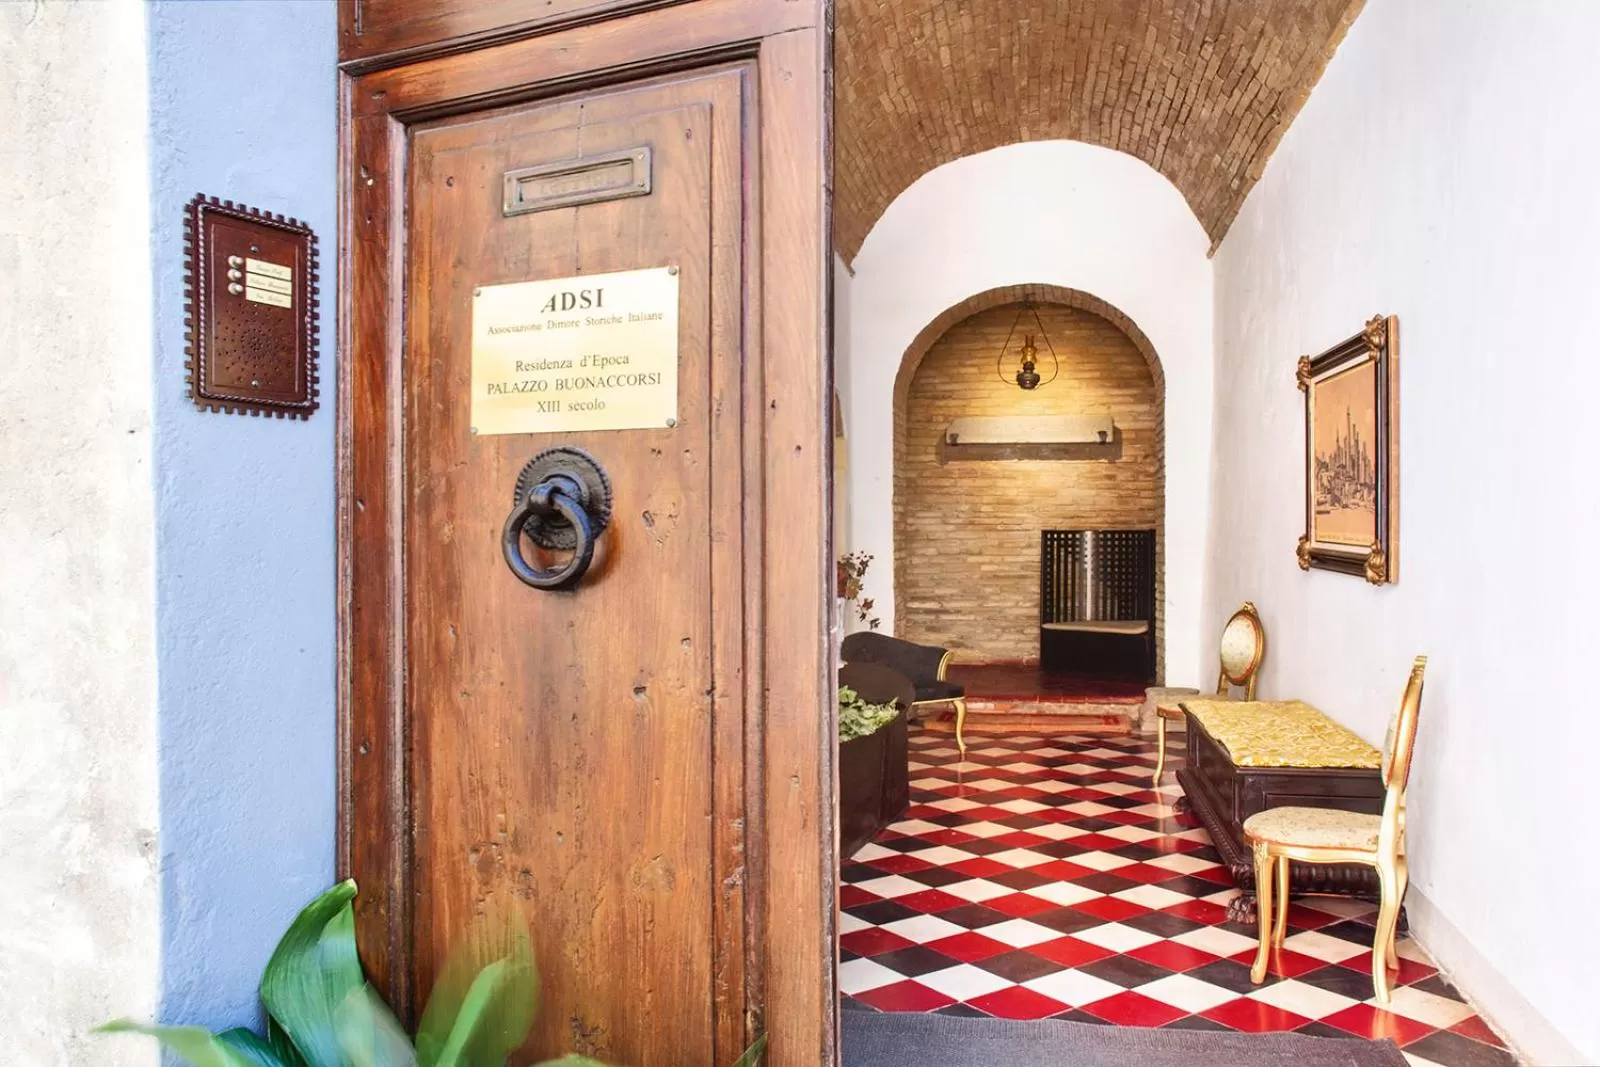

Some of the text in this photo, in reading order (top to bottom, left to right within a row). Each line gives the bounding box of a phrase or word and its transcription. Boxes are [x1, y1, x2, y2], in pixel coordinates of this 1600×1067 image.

[540, 288, 604, 313] ADSI
[547, 319, 580, 330] Dimore
[585, 314, 622, 326] Storiche
[628, 312, 663, 322] Italiane
[515, 354, 630, 372] Residenza d'Epoca
[487, 372, 661, 395] PALAZZO BUONACCORSI
[536, 398, 606, 413] XIII secolo
